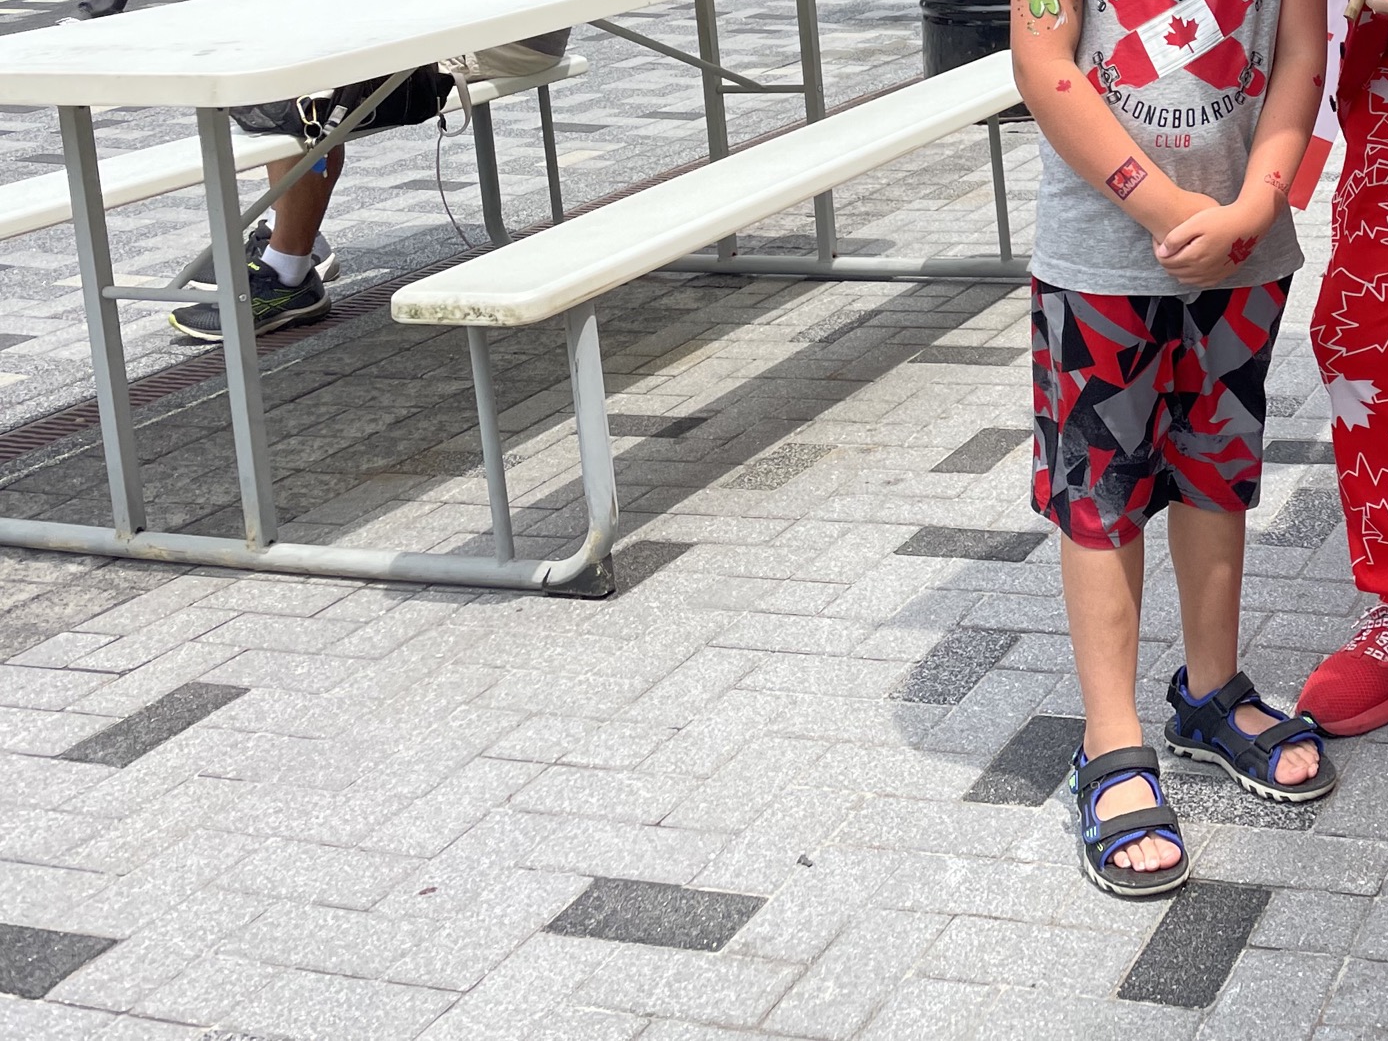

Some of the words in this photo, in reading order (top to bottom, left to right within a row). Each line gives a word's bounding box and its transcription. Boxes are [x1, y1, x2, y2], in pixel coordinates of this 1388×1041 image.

[1121, 93, 1235, 129] LONGBOARD
[1155, 134, 1191, 148] CLUB
[1118, 169, 1147, 198] CANADA
